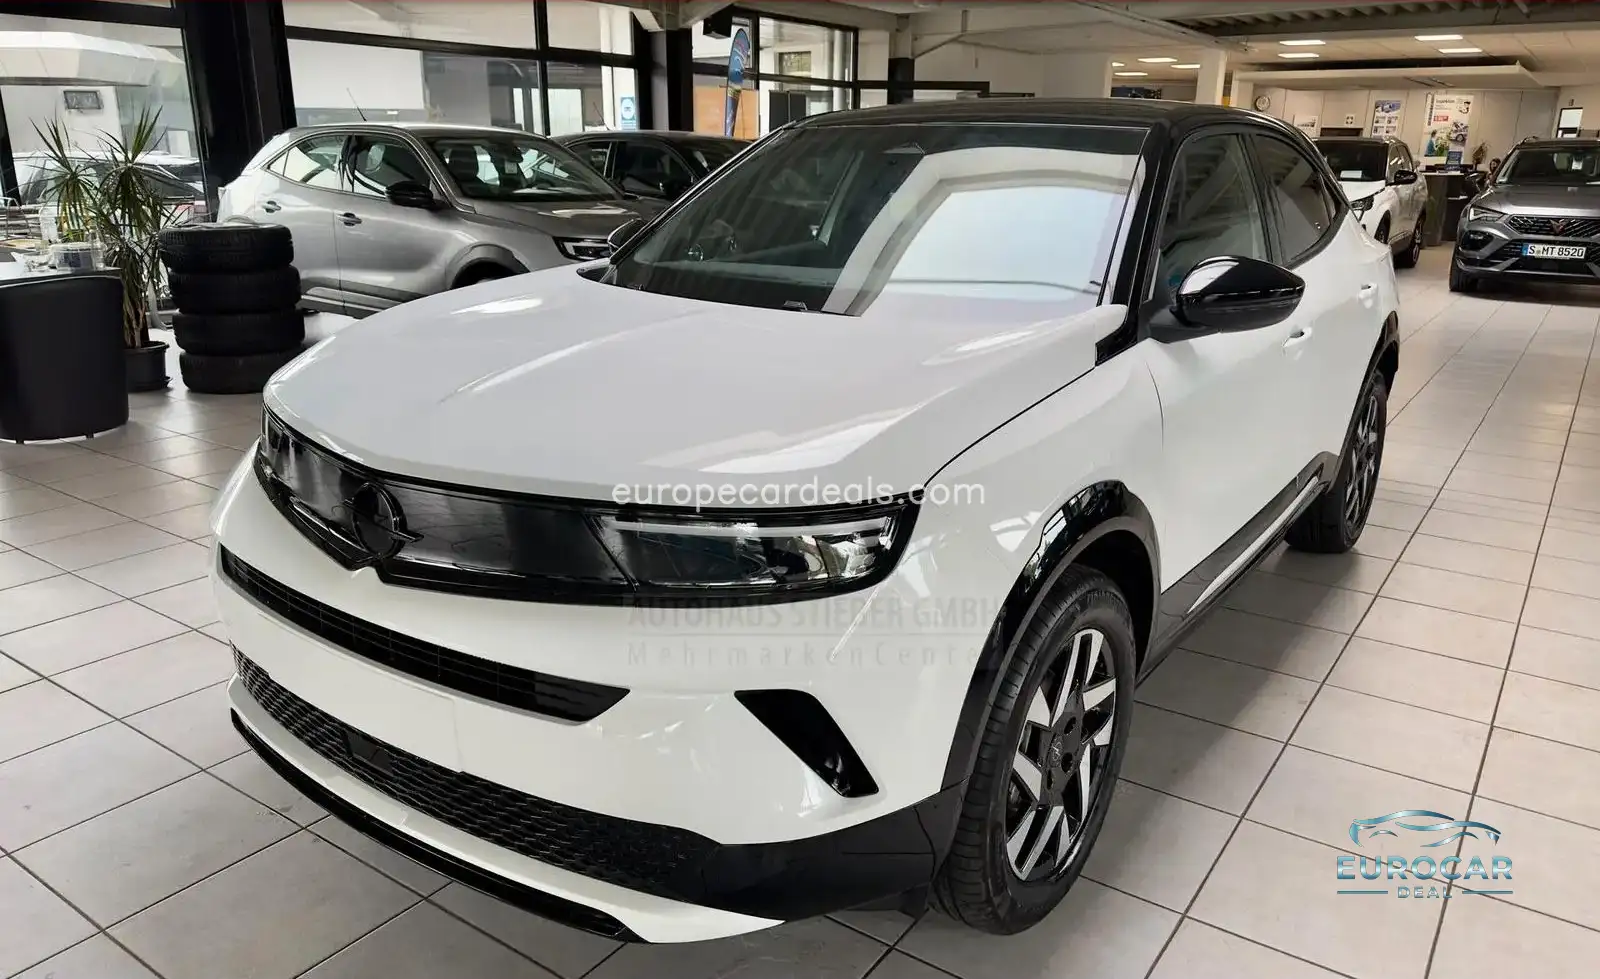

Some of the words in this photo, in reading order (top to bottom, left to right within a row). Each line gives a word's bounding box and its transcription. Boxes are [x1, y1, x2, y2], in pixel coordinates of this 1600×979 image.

[1528, 245, 1536, 255] S
[1541, 246, 1556, 256] MT
[1557, 246, 1584, 257] 8520
